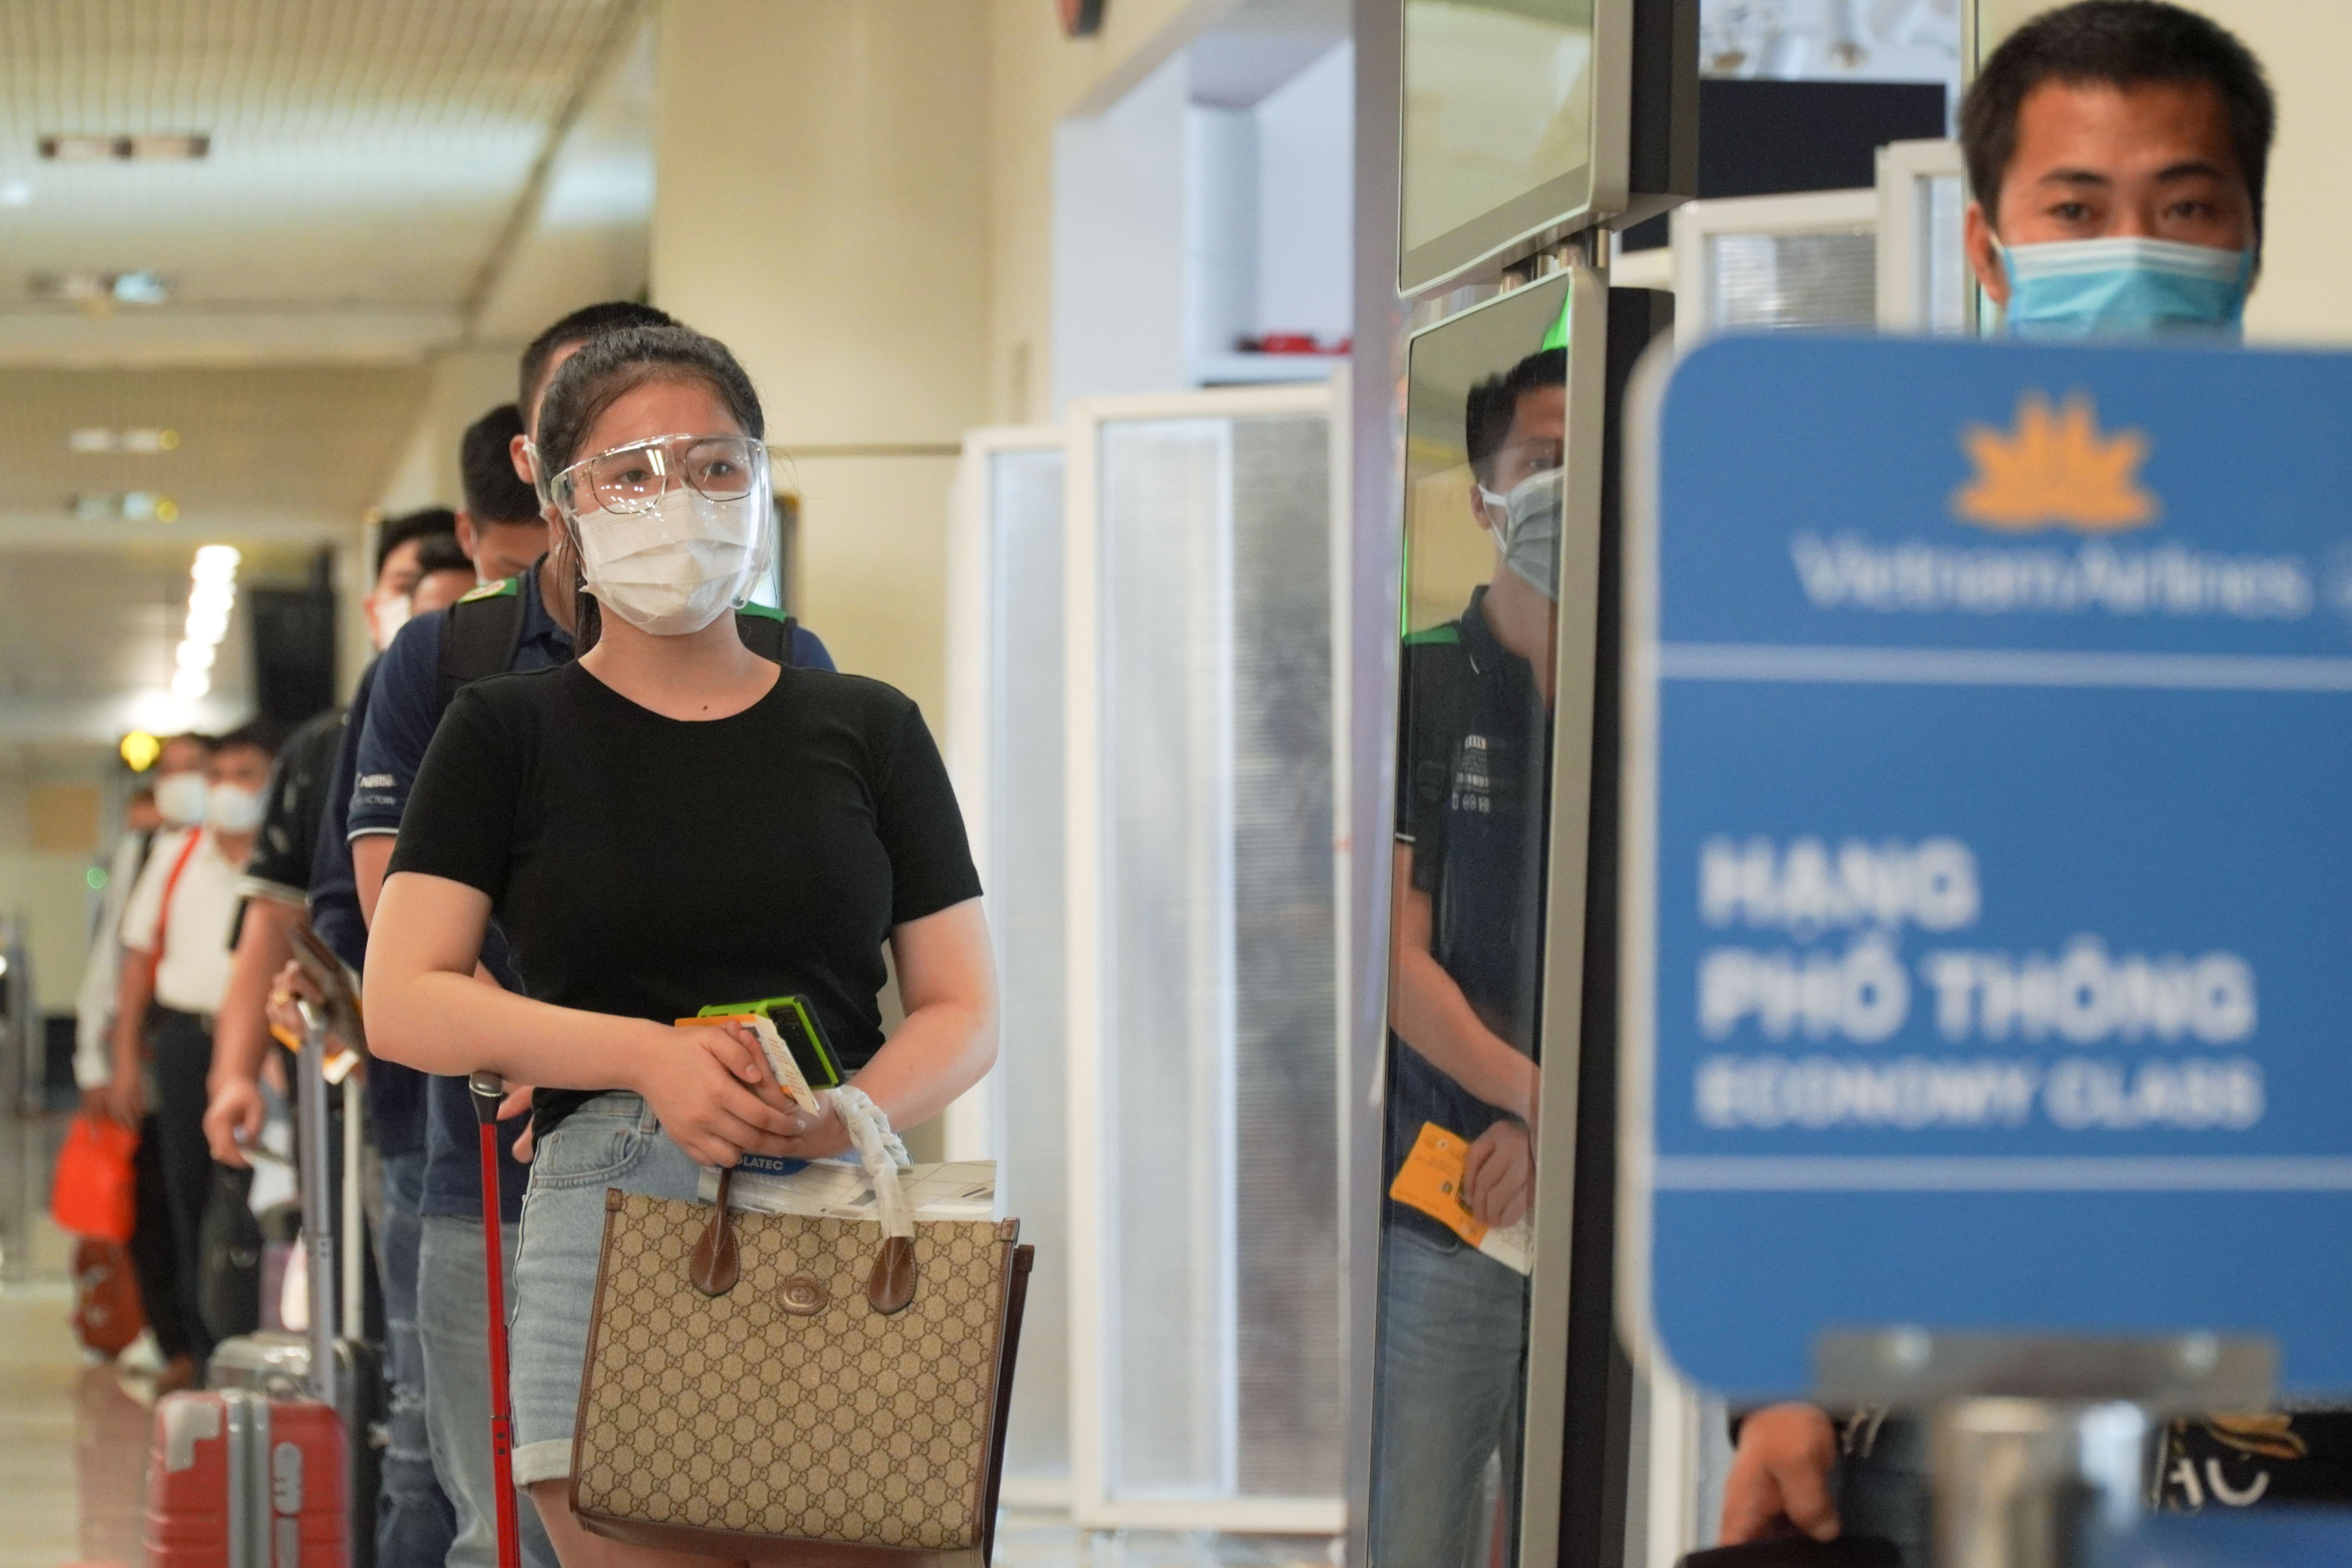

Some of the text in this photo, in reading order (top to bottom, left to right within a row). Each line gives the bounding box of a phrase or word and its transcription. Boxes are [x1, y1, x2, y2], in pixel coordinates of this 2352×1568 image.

[1700, 839, 1976, 940] HẠNG
[1921, 936, 2254, 1042] THÔNG
[1696, 1060, 2263, 1128] ECONOMY CLASS
